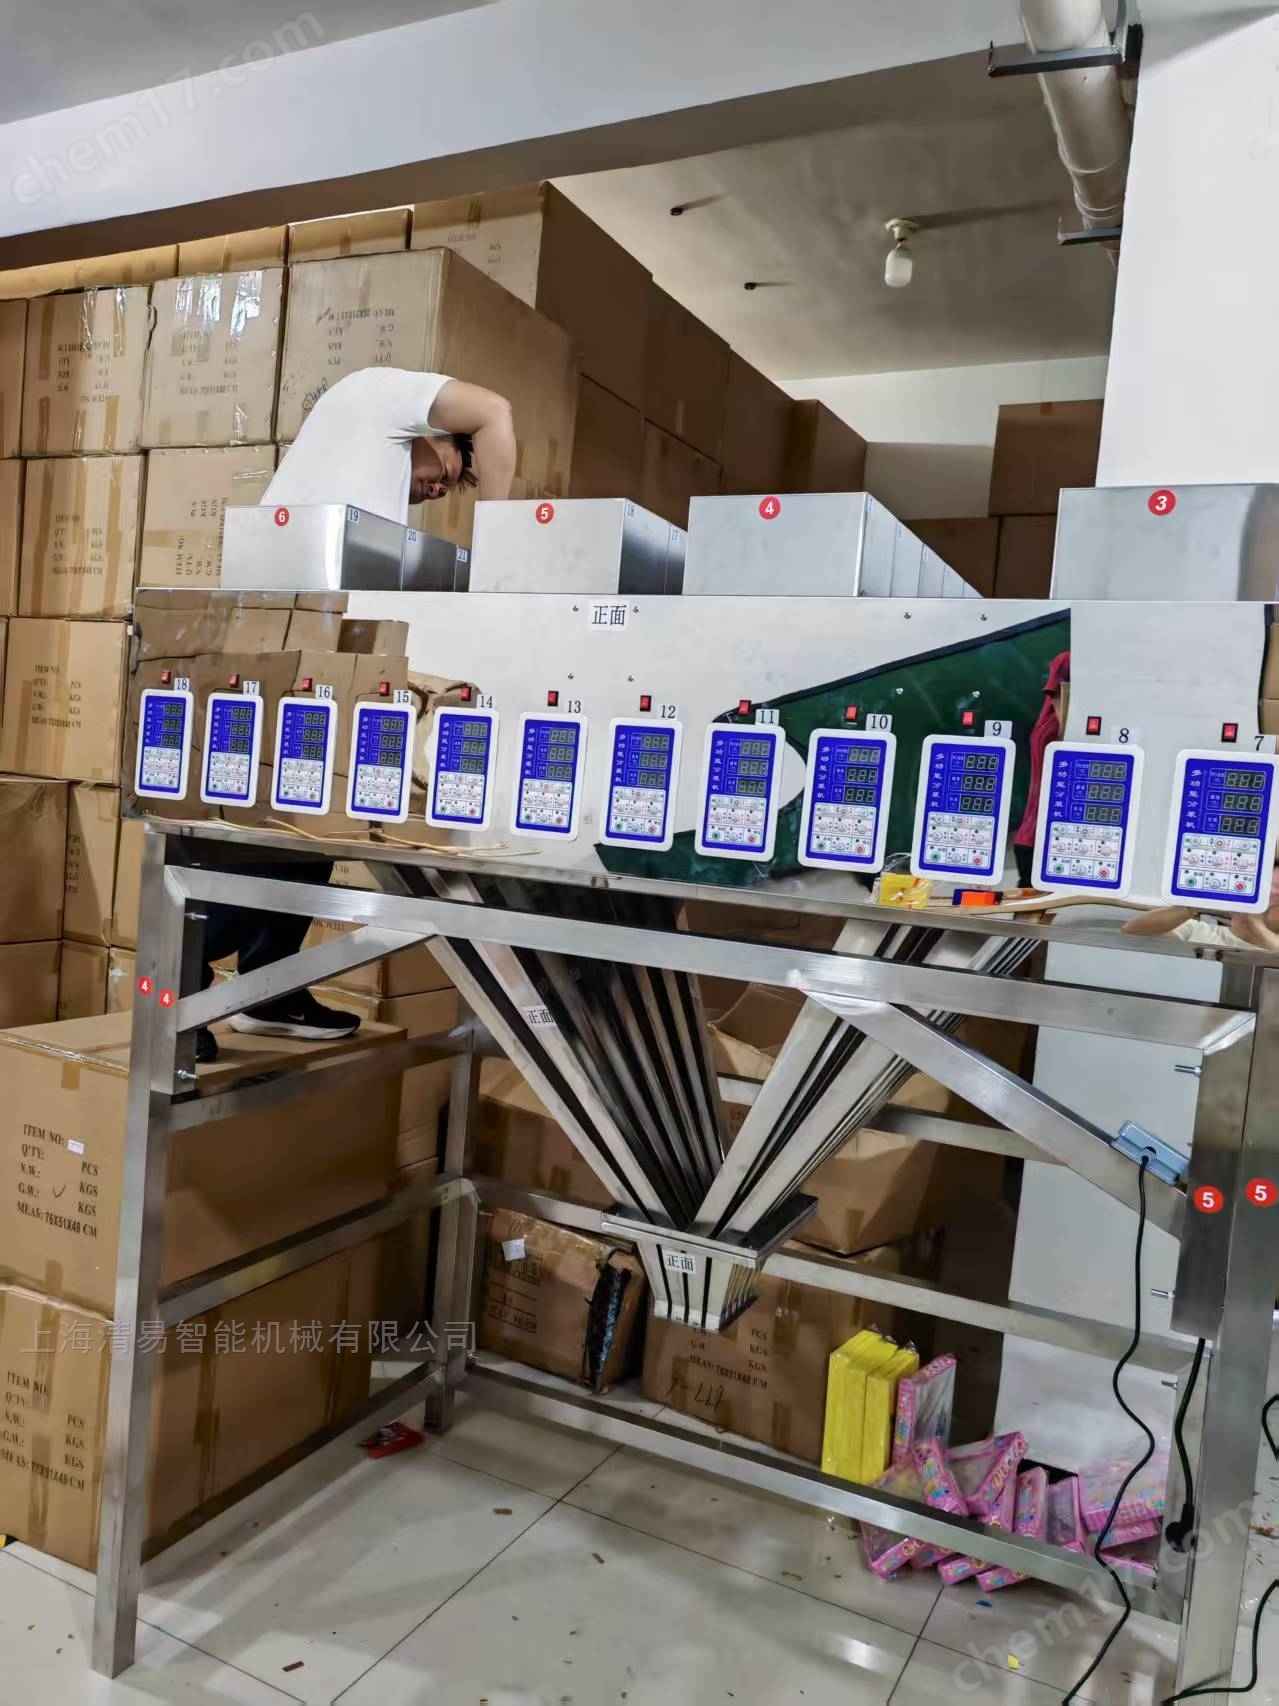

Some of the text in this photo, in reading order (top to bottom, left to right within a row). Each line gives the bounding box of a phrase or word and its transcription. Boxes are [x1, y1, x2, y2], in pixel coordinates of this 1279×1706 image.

[765, 502, 774, 514] 4
[1155, 496, 1167, 511] 3
[278, 511, 286, 522] 6
[349, 509, 359, 521] 19
[540, 508, 549, 519] 5
[408, 530, 417, 542] 20
[591, 604, 627, 626] 正面
[177, 679, 188, 690] 18
[246, 682, 258, 694] 17
[318, 686, 330, 698] 16
[397, 691, 409, 703] 15
[480, 696, 493, 708] 14
[567, 700, 581, 713] 13
[661, 705, 676, 718] 12
[759, 710, 775, 723] 11
[871, 715, 888, 729] 10
[992, 722, 1002, 736] 9
[1119, 728, 1130, 743] 8
[1254, 735, 1264, 751] 7
[142, 981, 149, 991] 4
[163, 994, 170, 1004] 4
[526, 1009, 554, 1024] 正面
[23, 1123, 46, 1140] ITEM
[49, 1131, 65, 1145] NO:
[81, 1161, 99, 1176] PCS
[79, 1181, 98, 1197] KGS
[1255, 1185, 1267, 1201] 5
[1203, 1192, 1214, 1208] 5
[78, 1201, 97, 1217] KGS
[668, 1255, 693, 1271] 正面
[67, 1414, 85, 1430] PCS
[66, 1433, 84, 1449] KGS
[64, 1454, 84, 1470] KGS
